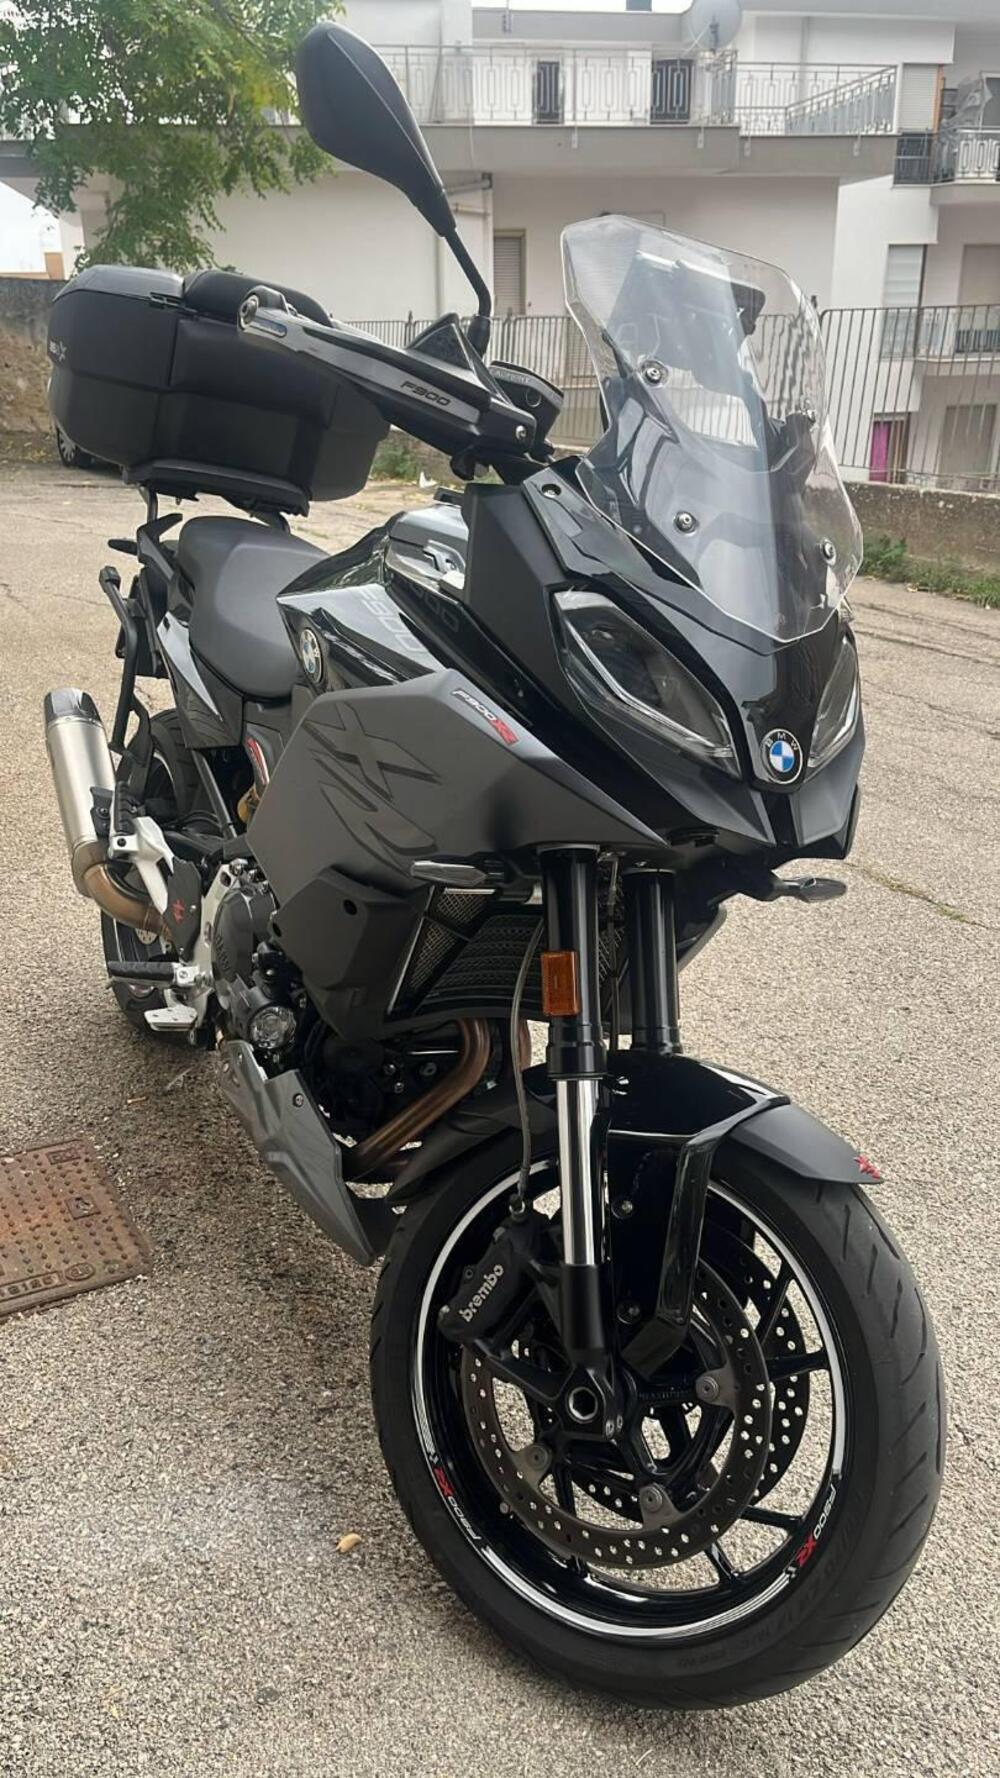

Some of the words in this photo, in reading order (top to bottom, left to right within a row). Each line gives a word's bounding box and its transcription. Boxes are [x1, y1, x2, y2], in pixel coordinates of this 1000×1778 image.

[401, 381, 451, 406] F900
[764, 732, 800, 751] BMW
[459, 1265, 504, 1322] brembo
[796, 1484, 837, 1568] F900XR
